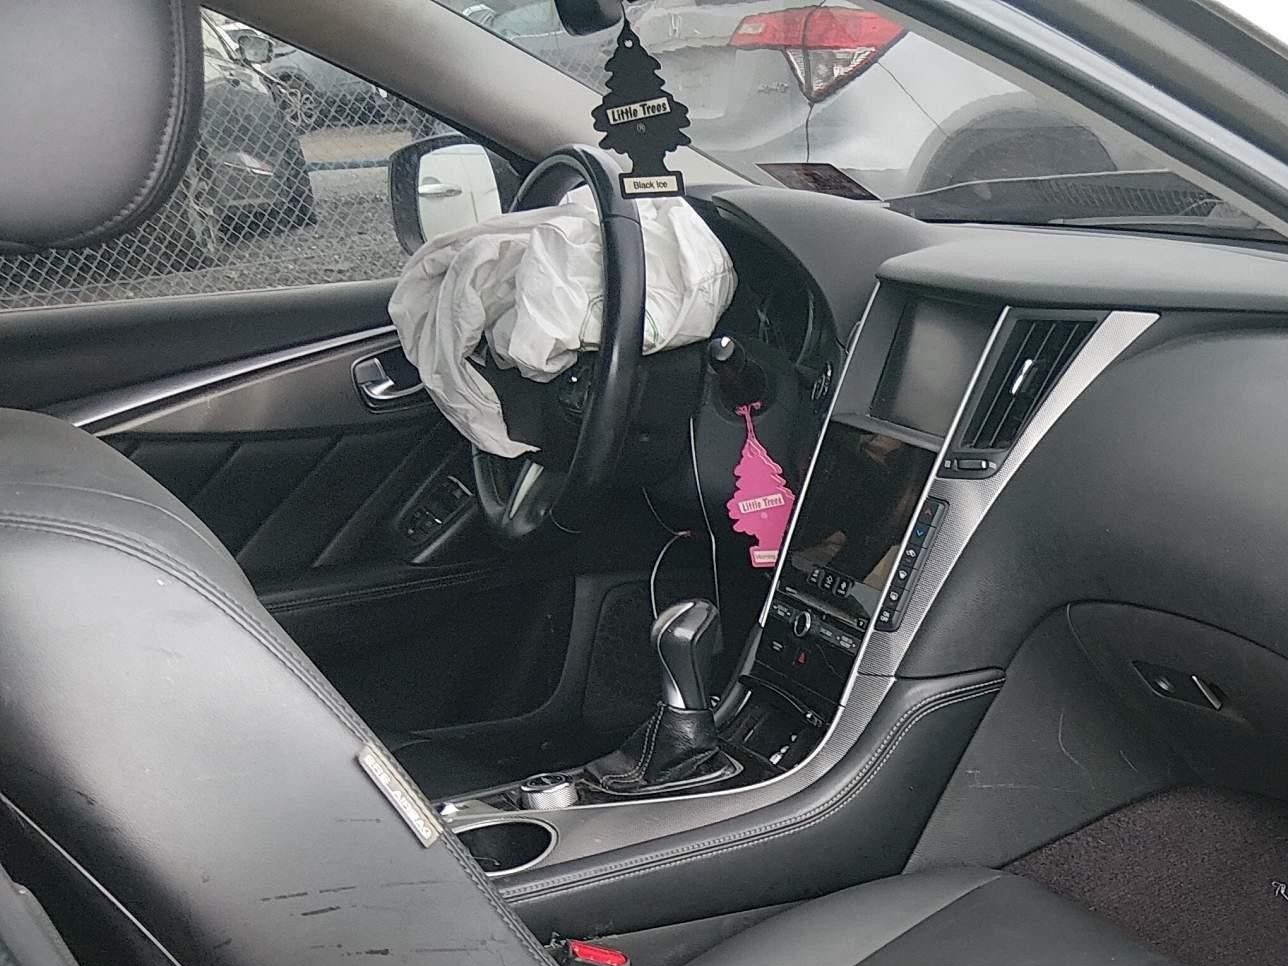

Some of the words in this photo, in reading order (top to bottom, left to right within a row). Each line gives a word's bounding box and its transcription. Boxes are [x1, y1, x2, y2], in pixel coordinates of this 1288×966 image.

[611, 106, 638, 122] Little
[639, 102, 667, 116] Trees
[633, 181, 655, 190] Black
[742, 500, 761, 512] Little
[763, 497, 782, 507] Trees
